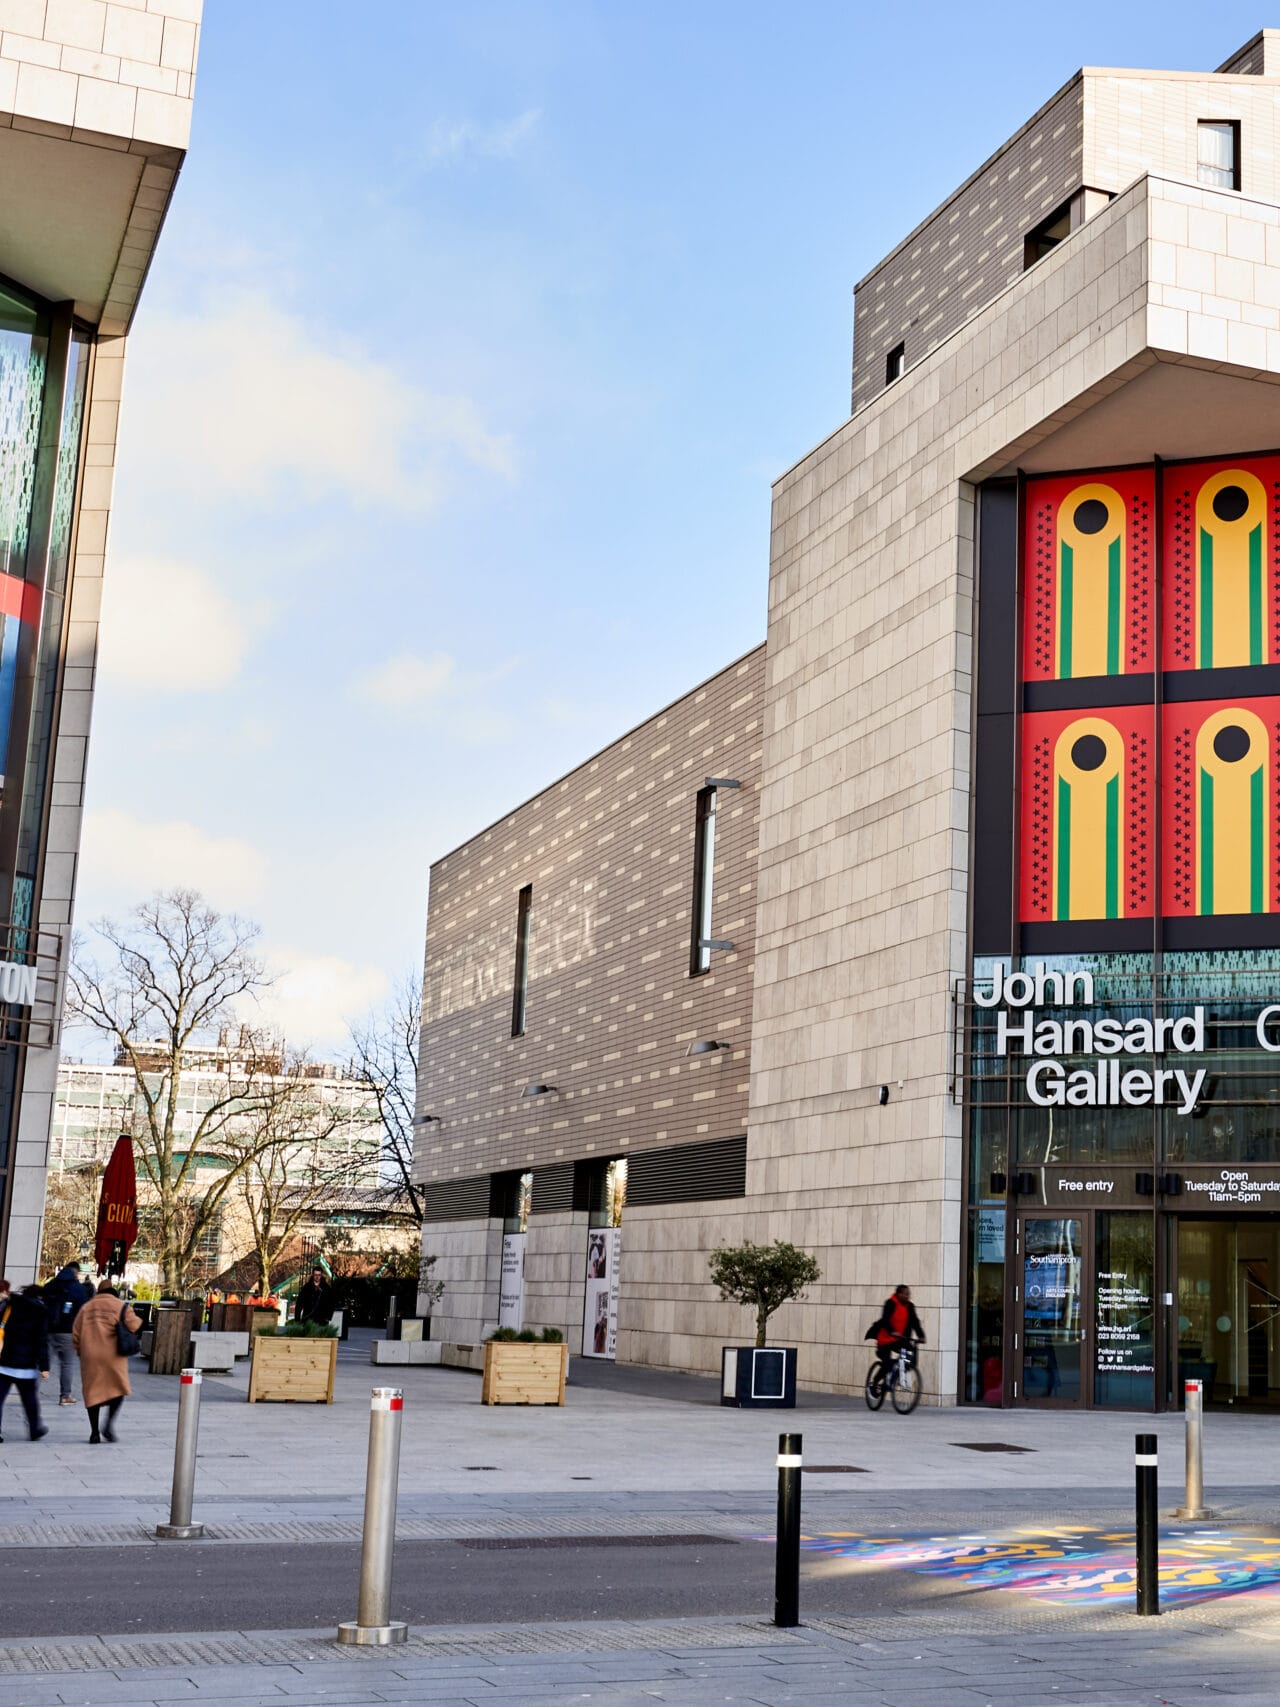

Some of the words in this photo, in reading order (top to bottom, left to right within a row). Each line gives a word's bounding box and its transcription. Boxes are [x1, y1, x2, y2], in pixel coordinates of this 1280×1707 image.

[973, 962, 1094, 1007] John
[997, 1006, 1205, 1056] Hansard
[1026, 1058, 1207, 1115] Gallery
[1220, 1171, 1249, 1182] Open
[1058, 1180, 1084, 1191] Free
[1085, 1180, 1114, 1193] entry
[1185, 1181, 1226, 1193] Tuesday
[1227, 1181, 1239, 1191] to
[1030, 1255, 1077, 1265] Southampton
[1112, 1272, 1127, 1280] Entry
